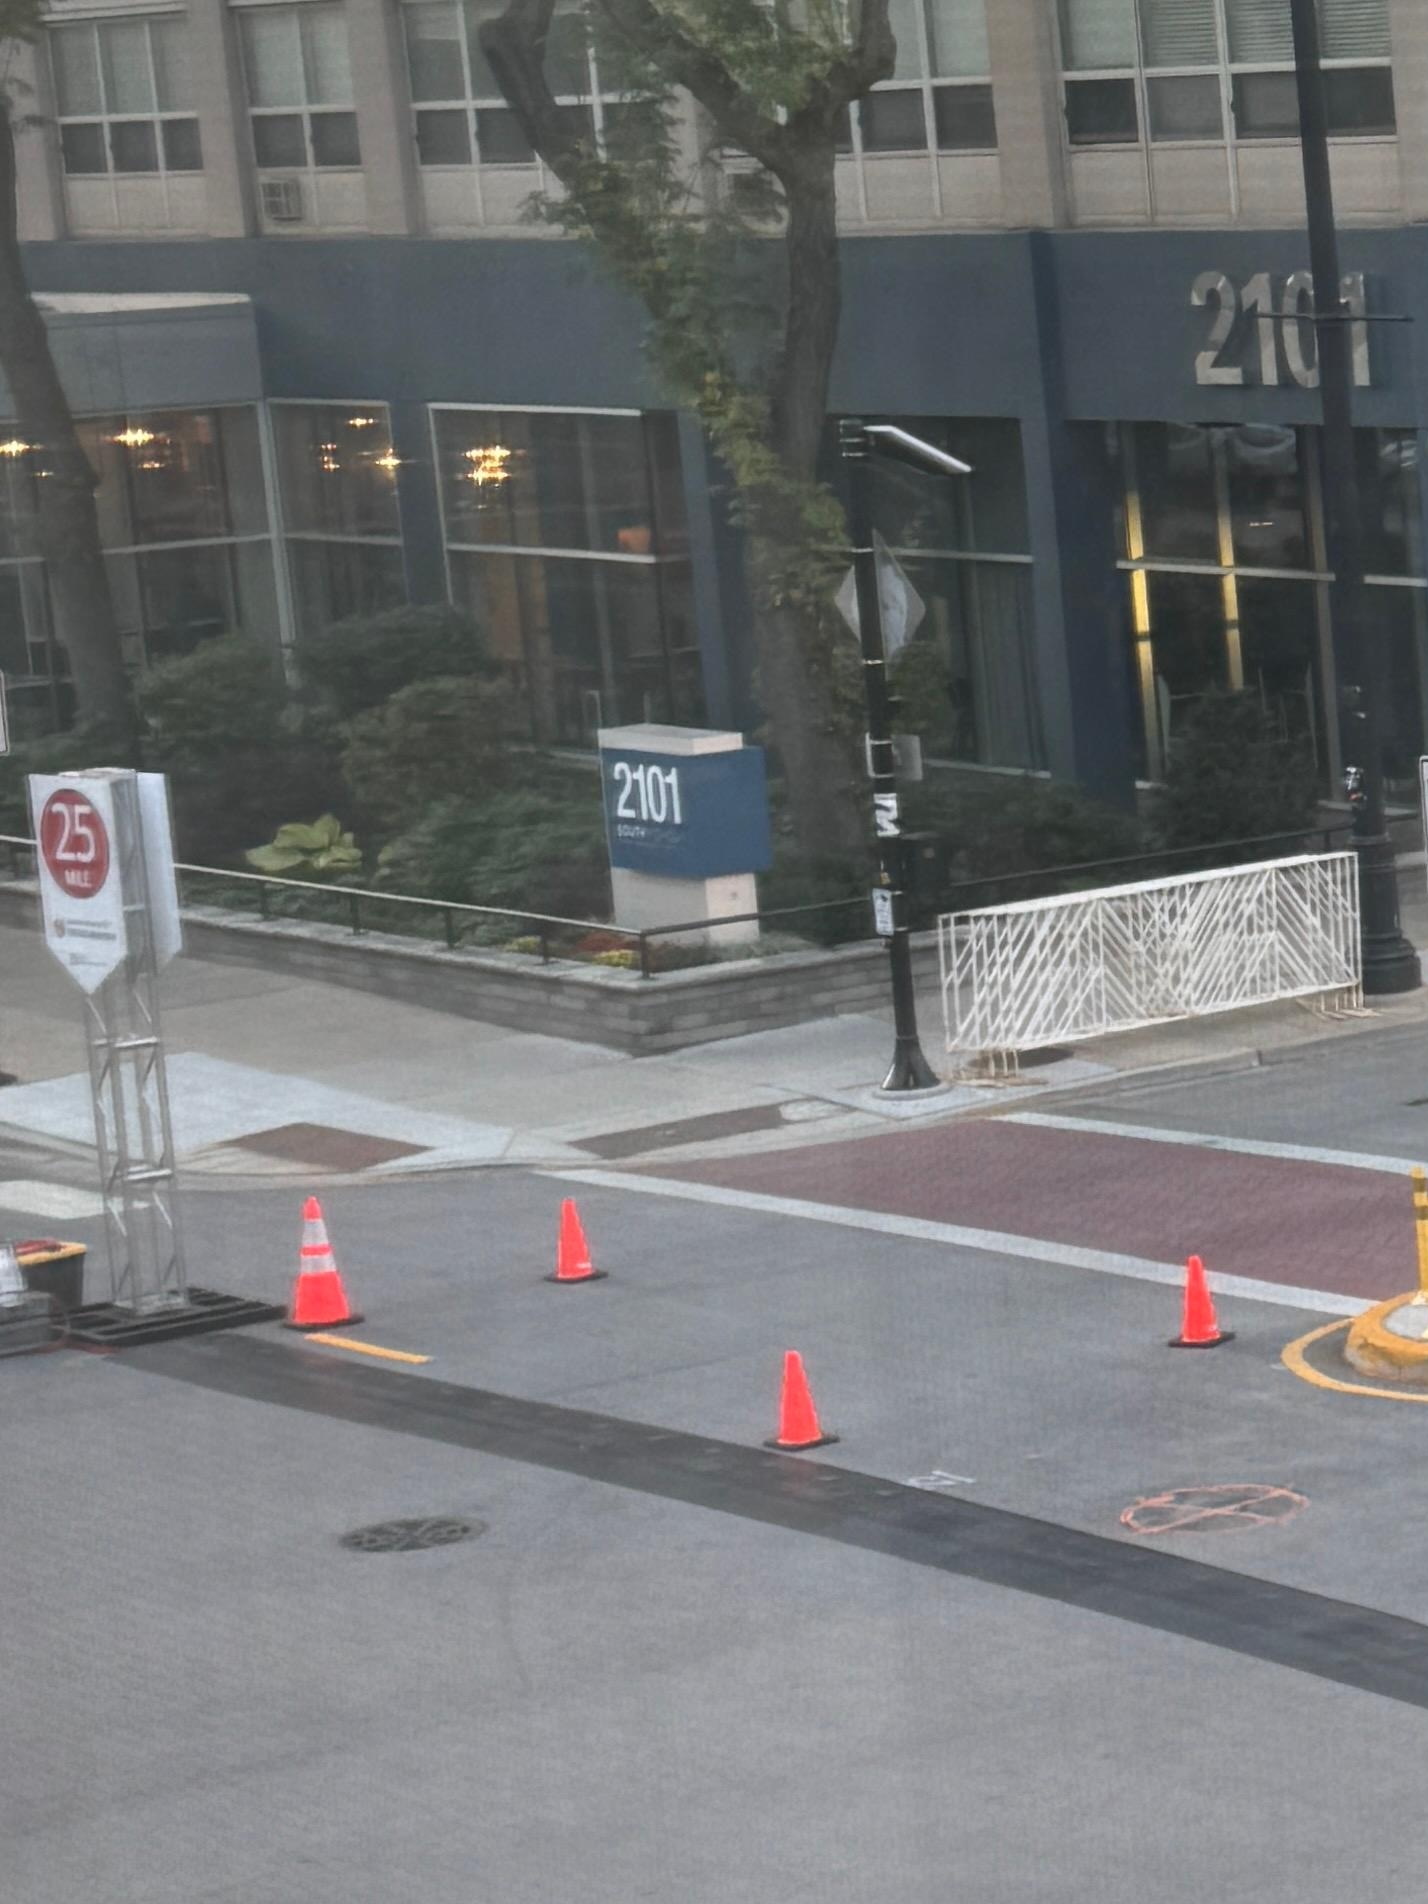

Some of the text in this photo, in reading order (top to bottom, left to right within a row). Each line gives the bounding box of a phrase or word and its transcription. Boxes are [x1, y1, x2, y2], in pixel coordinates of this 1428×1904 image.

[1191, 270, 1371, 388] 2101
[613, 761, 682, 825] 2101
[51, 802, 96, 863] 25
[64, 868, 92, 888] MILE
